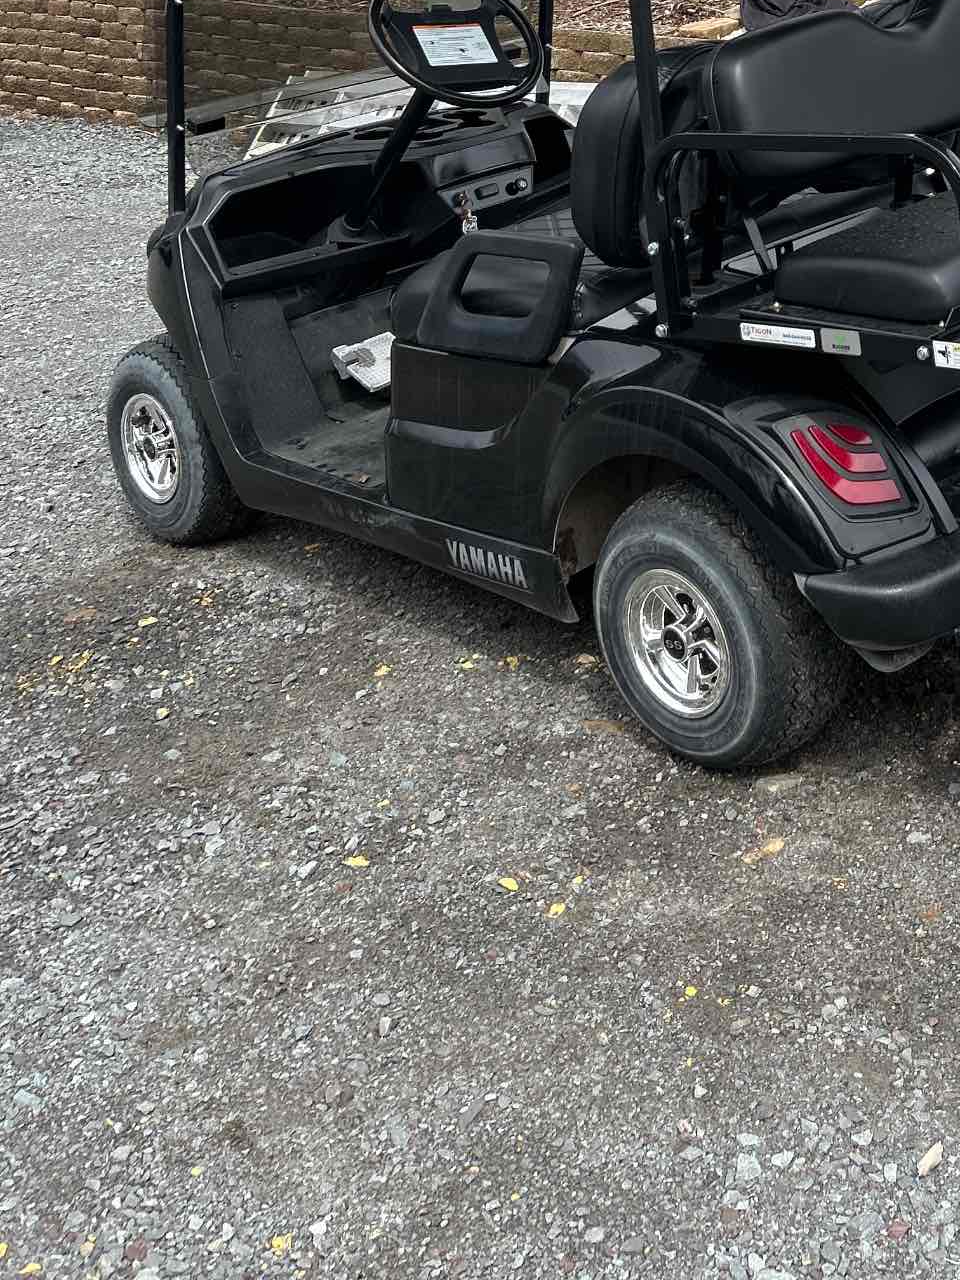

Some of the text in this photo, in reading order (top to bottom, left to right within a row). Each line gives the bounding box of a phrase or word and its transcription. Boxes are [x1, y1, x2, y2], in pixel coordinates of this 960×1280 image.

[750, 326, 772, 336] TIGON
[446, 538, 528, 589] YAMAHA
[665, 639, 682, 650] SS
